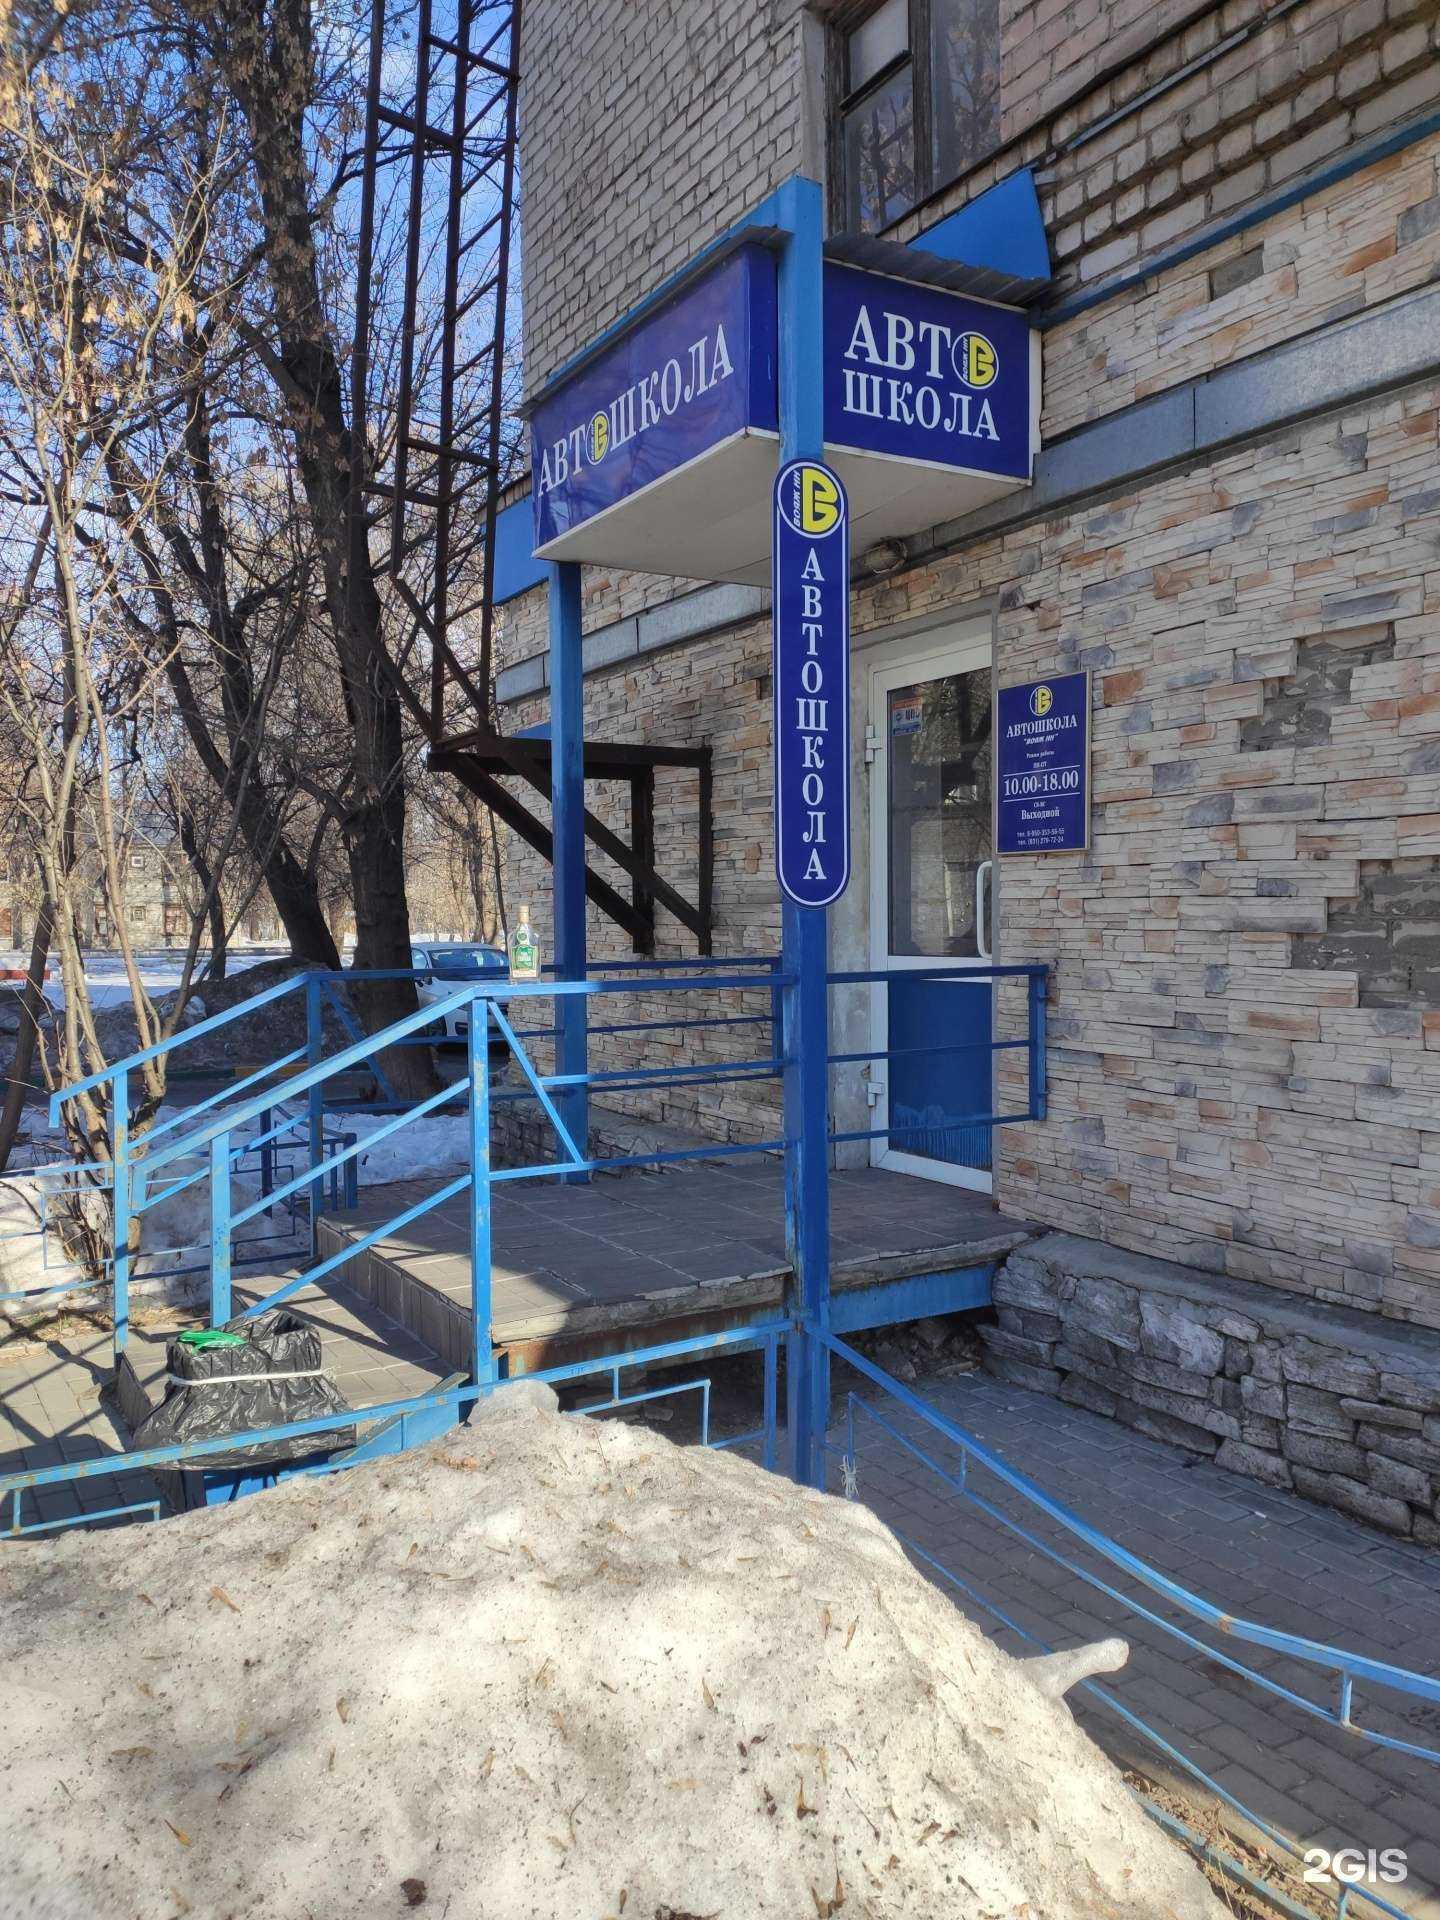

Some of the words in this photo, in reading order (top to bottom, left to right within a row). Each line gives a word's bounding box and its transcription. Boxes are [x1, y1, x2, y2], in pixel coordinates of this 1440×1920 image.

[843, 368, 1000, 441] ШКОЛА
[796, 548, 829, 880] АВТОШКОЛА
[1006, 714, 1078, 738] АВТОШКОЛА
[1003, 769, 1079, 796] 10.00-18.00
[1021, 806, 1060, 820] Выходной
